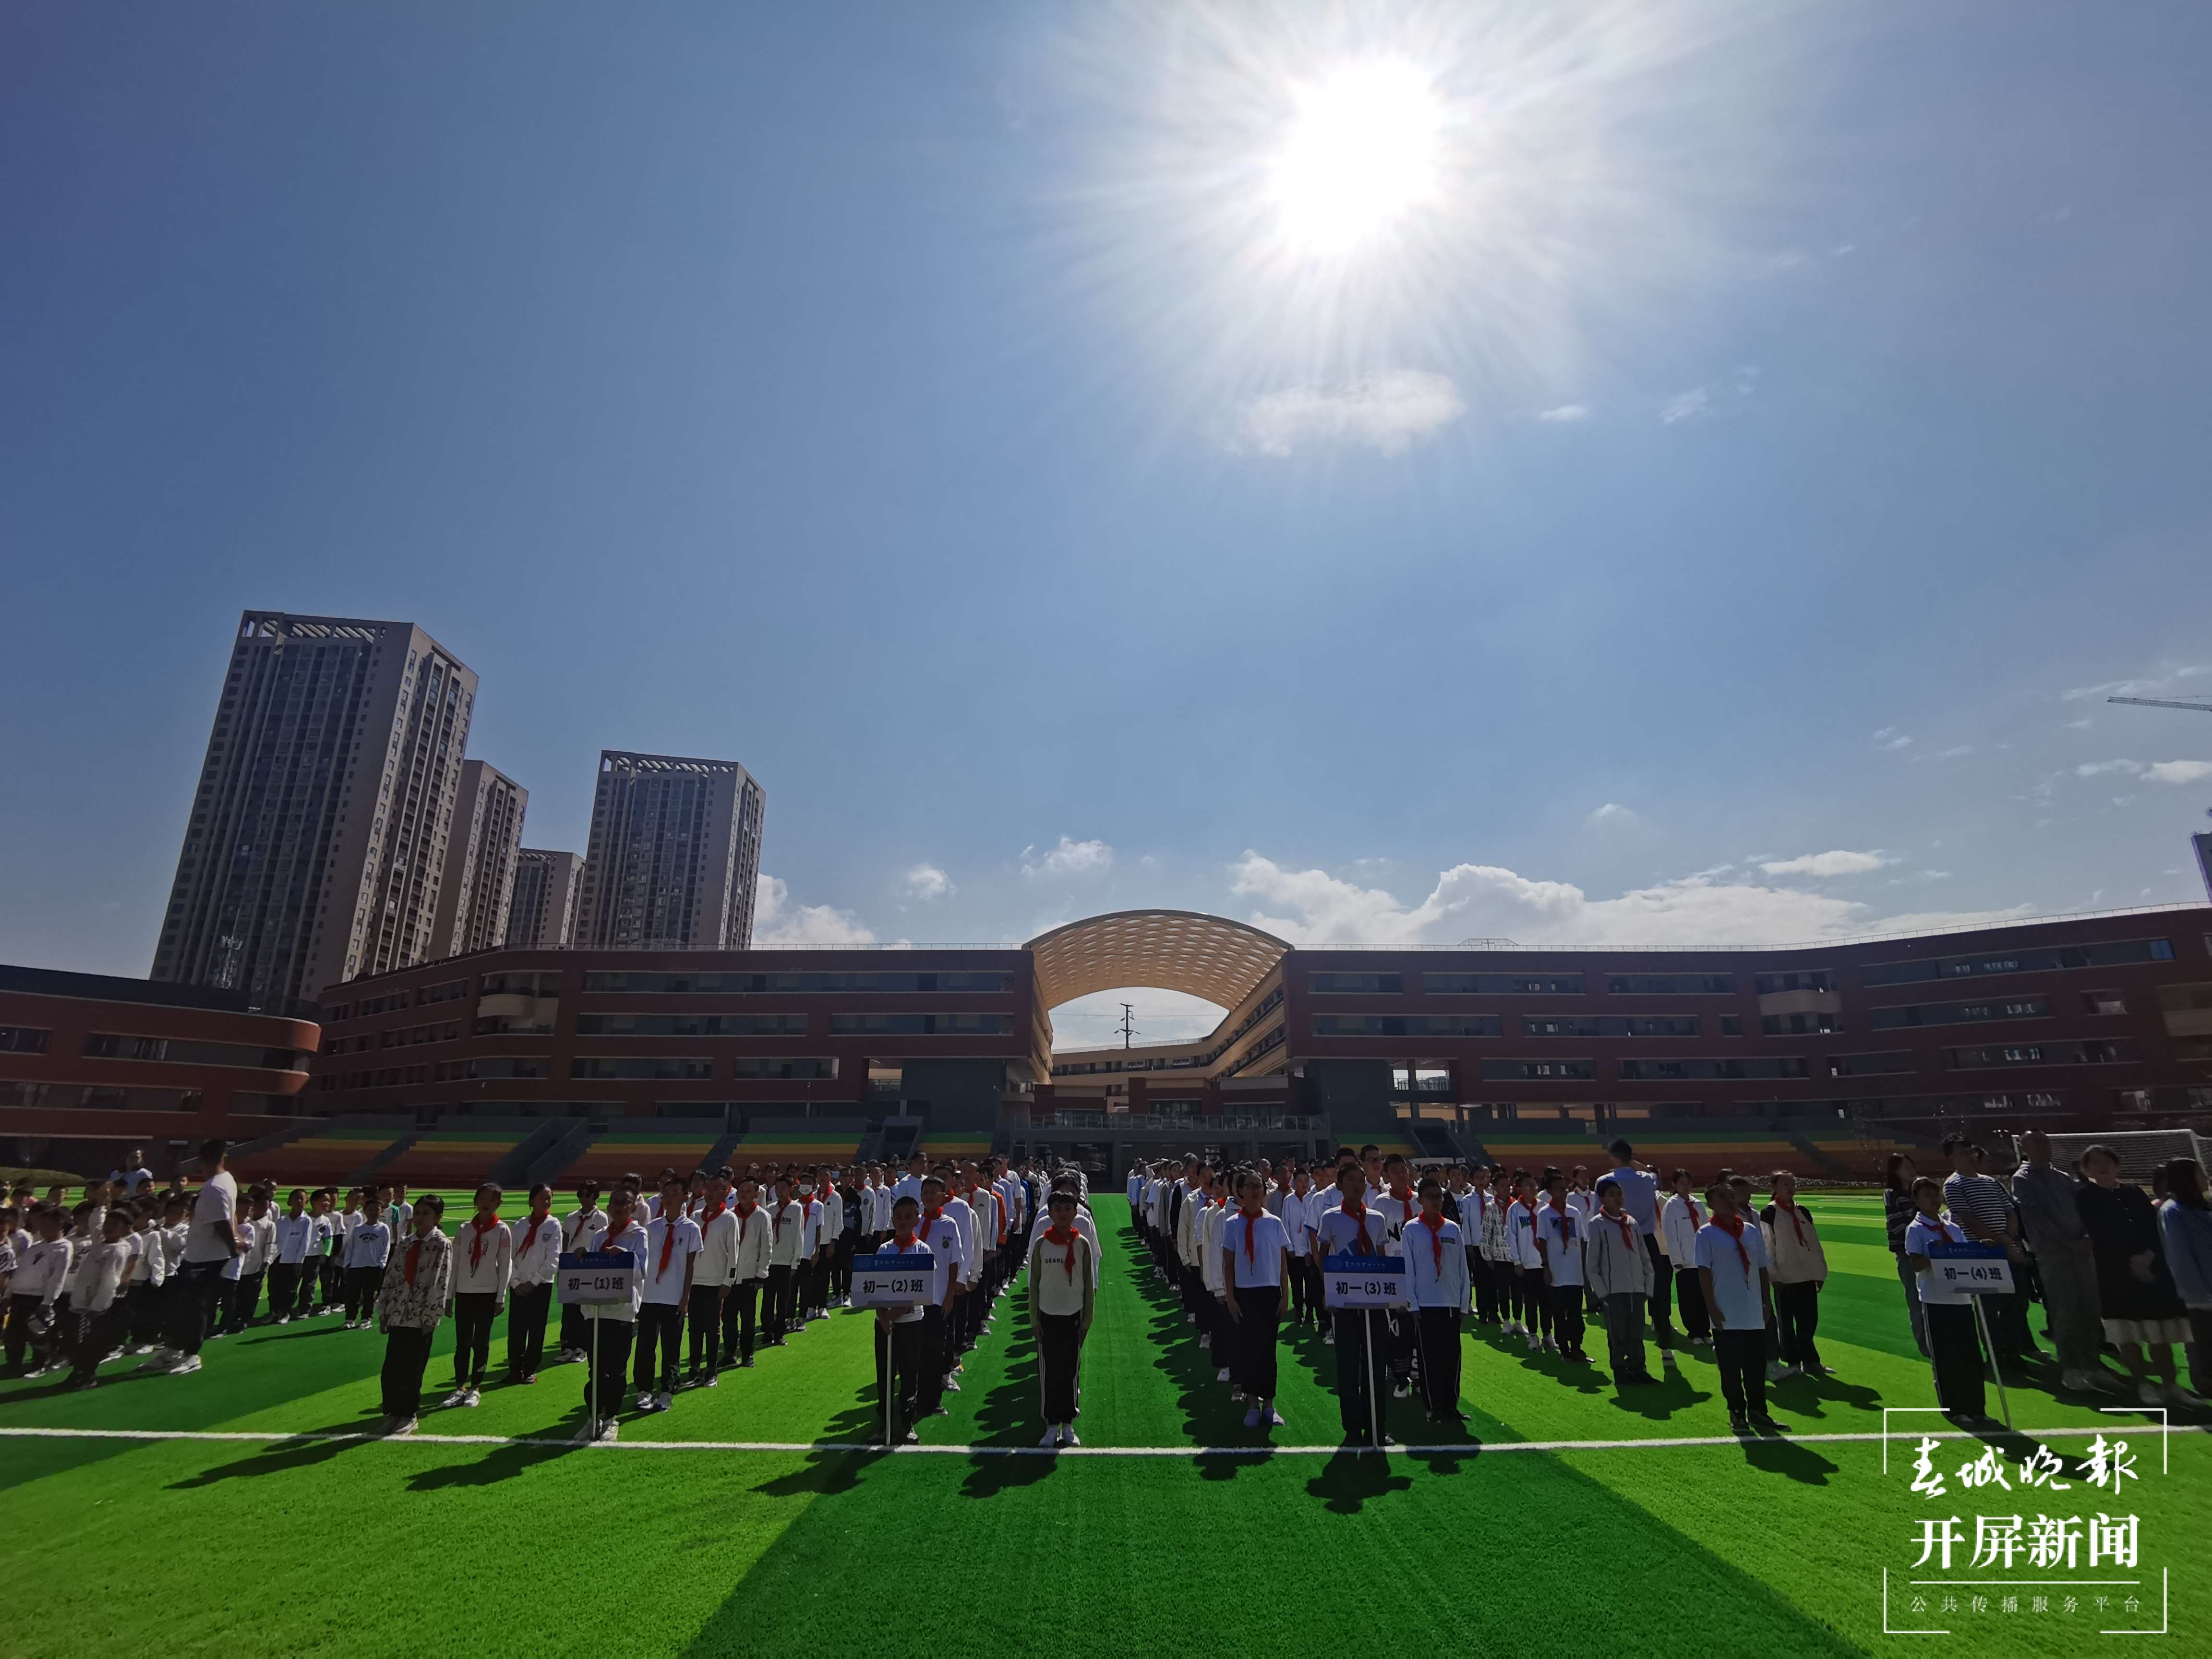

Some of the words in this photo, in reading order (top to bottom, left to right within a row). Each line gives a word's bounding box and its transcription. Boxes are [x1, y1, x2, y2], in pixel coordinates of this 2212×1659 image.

[1944, 1266, 2003, 1280] 初一(4)班
[567, 1276, 624, 1290] 初一(1)班
[863, 1278, 924, 1293] 初一(2)班
[1335, 1281, 1397, 1296] 初一(3)班
